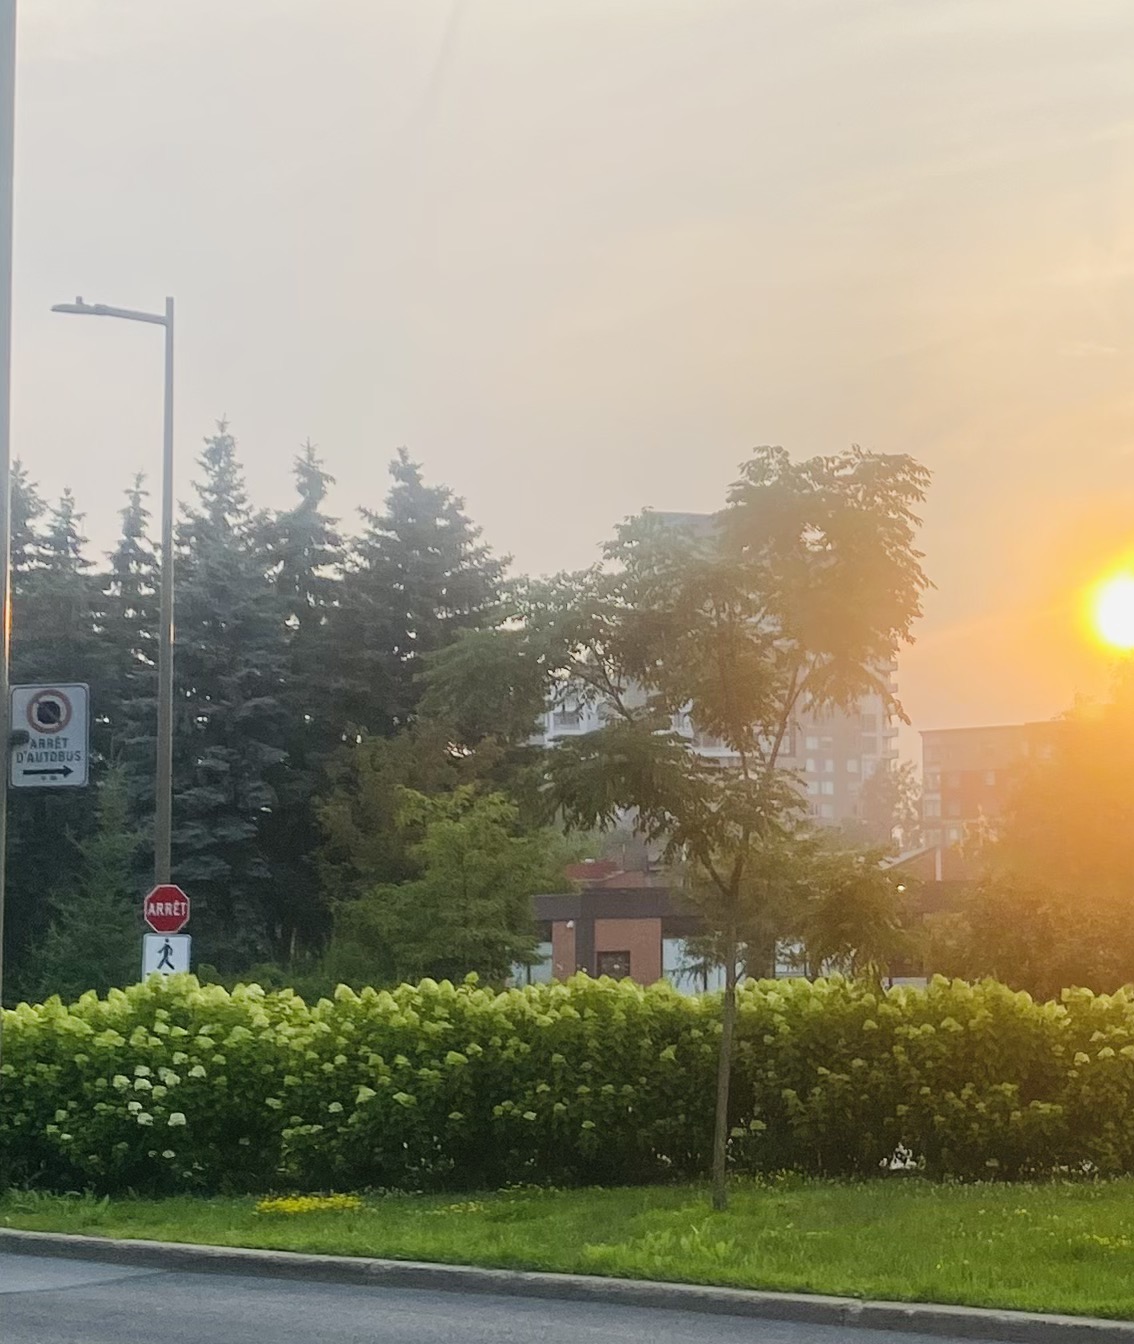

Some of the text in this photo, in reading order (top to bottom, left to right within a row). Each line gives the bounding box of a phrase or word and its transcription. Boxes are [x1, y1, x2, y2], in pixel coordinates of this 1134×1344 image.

[30, 736, 69, 750] ARRÊT
[16, 751, 81, 763] D'AUTOBUS
[147, 900, 187, 917] ARRÊT
